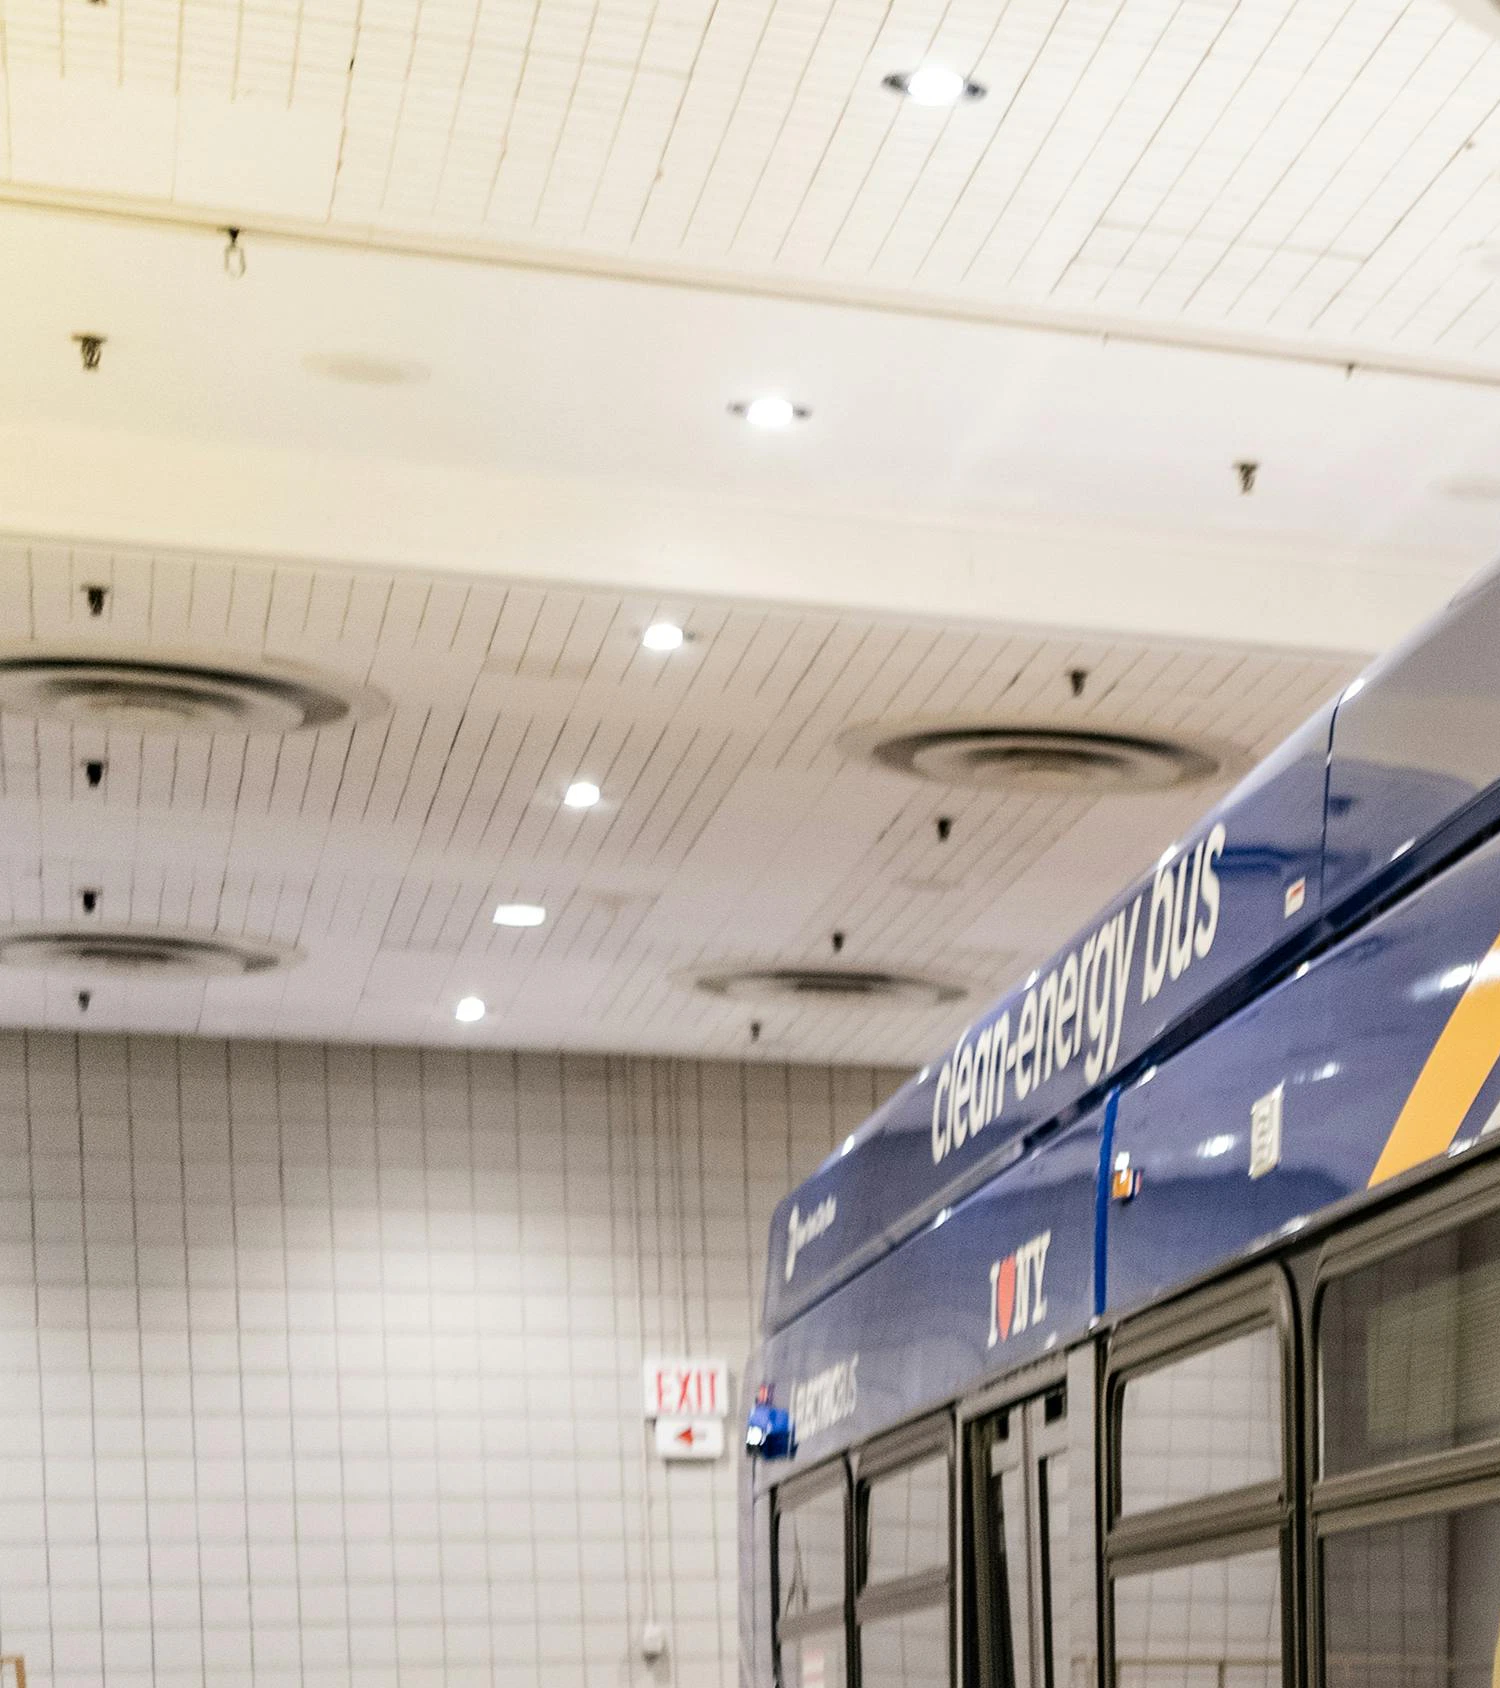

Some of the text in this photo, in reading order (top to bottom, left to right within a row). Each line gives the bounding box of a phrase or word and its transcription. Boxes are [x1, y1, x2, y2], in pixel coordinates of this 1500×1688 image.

[932, 822, 1227, 1166] clean-energy bus
[1012, 1229, 1052, 1337] NY
[656, 1368, 719, 1415] EXIT
